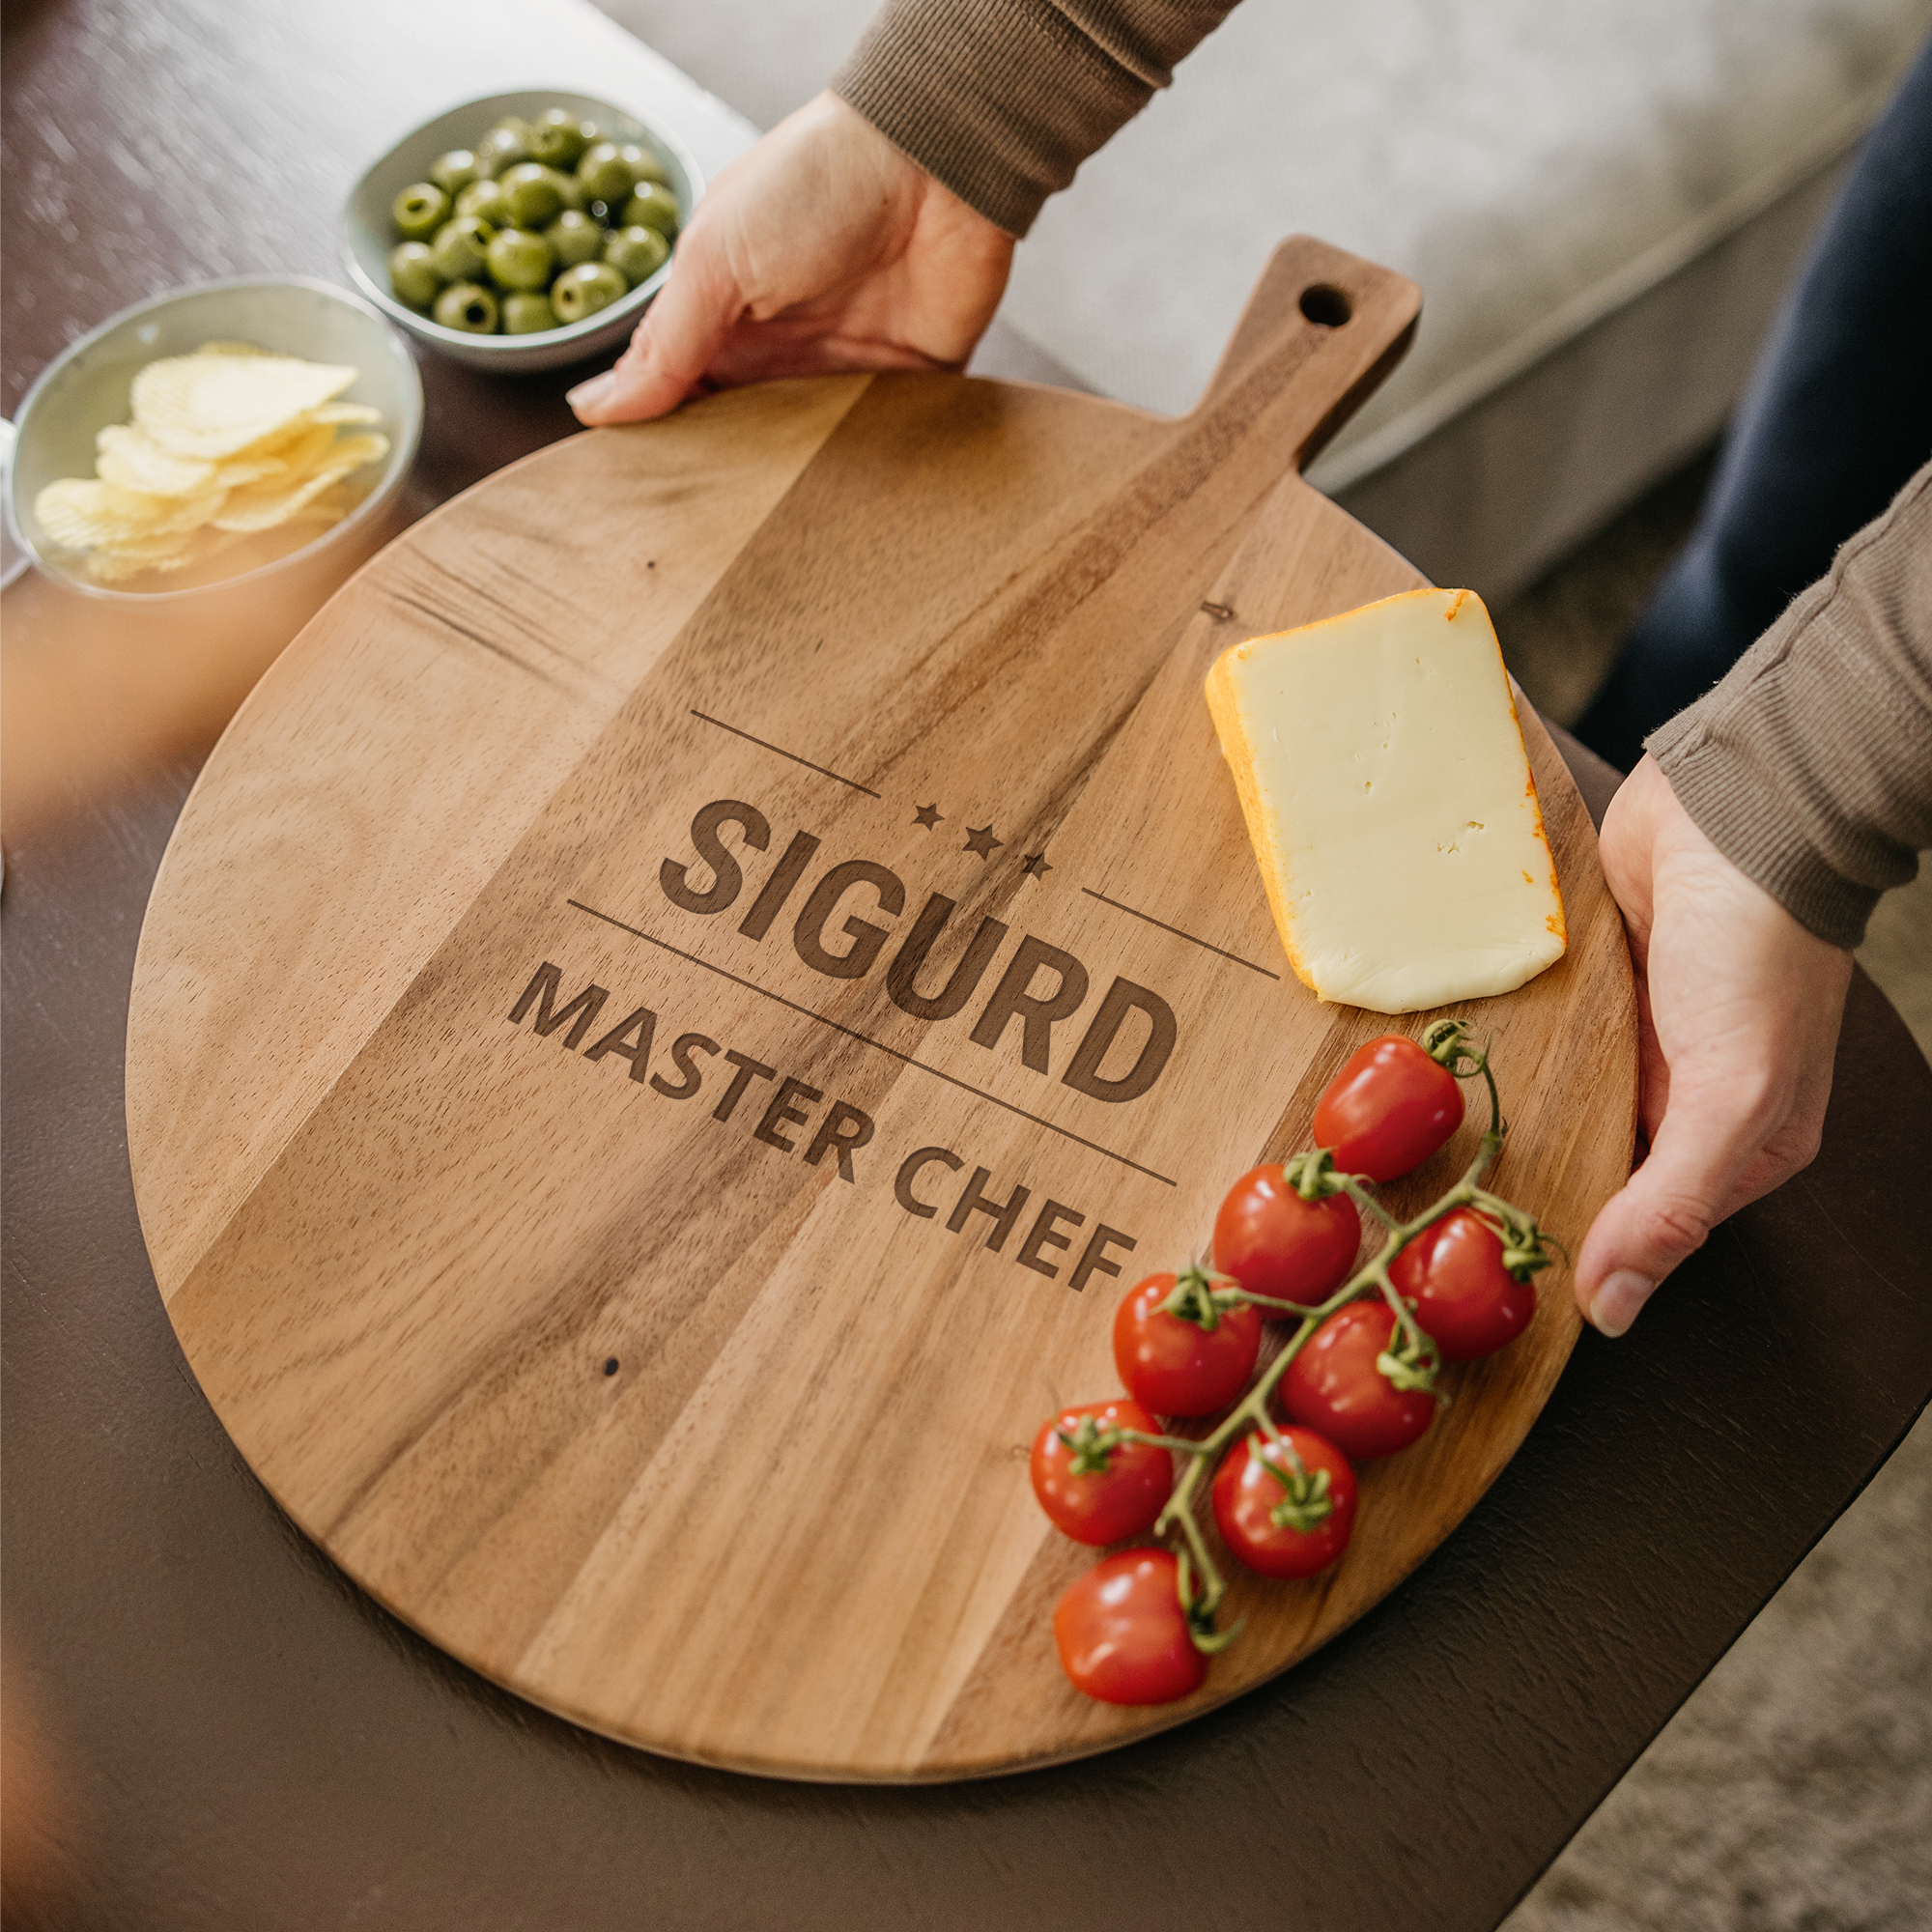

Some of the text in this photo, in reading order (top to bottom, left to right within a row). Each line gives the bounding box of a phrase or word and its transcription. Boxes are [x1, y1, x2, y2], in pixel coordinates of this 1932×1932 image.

[659, 799, 1178, 1103] SIGURD
[507, 961, 1138, 1293] MASTER CHEF
